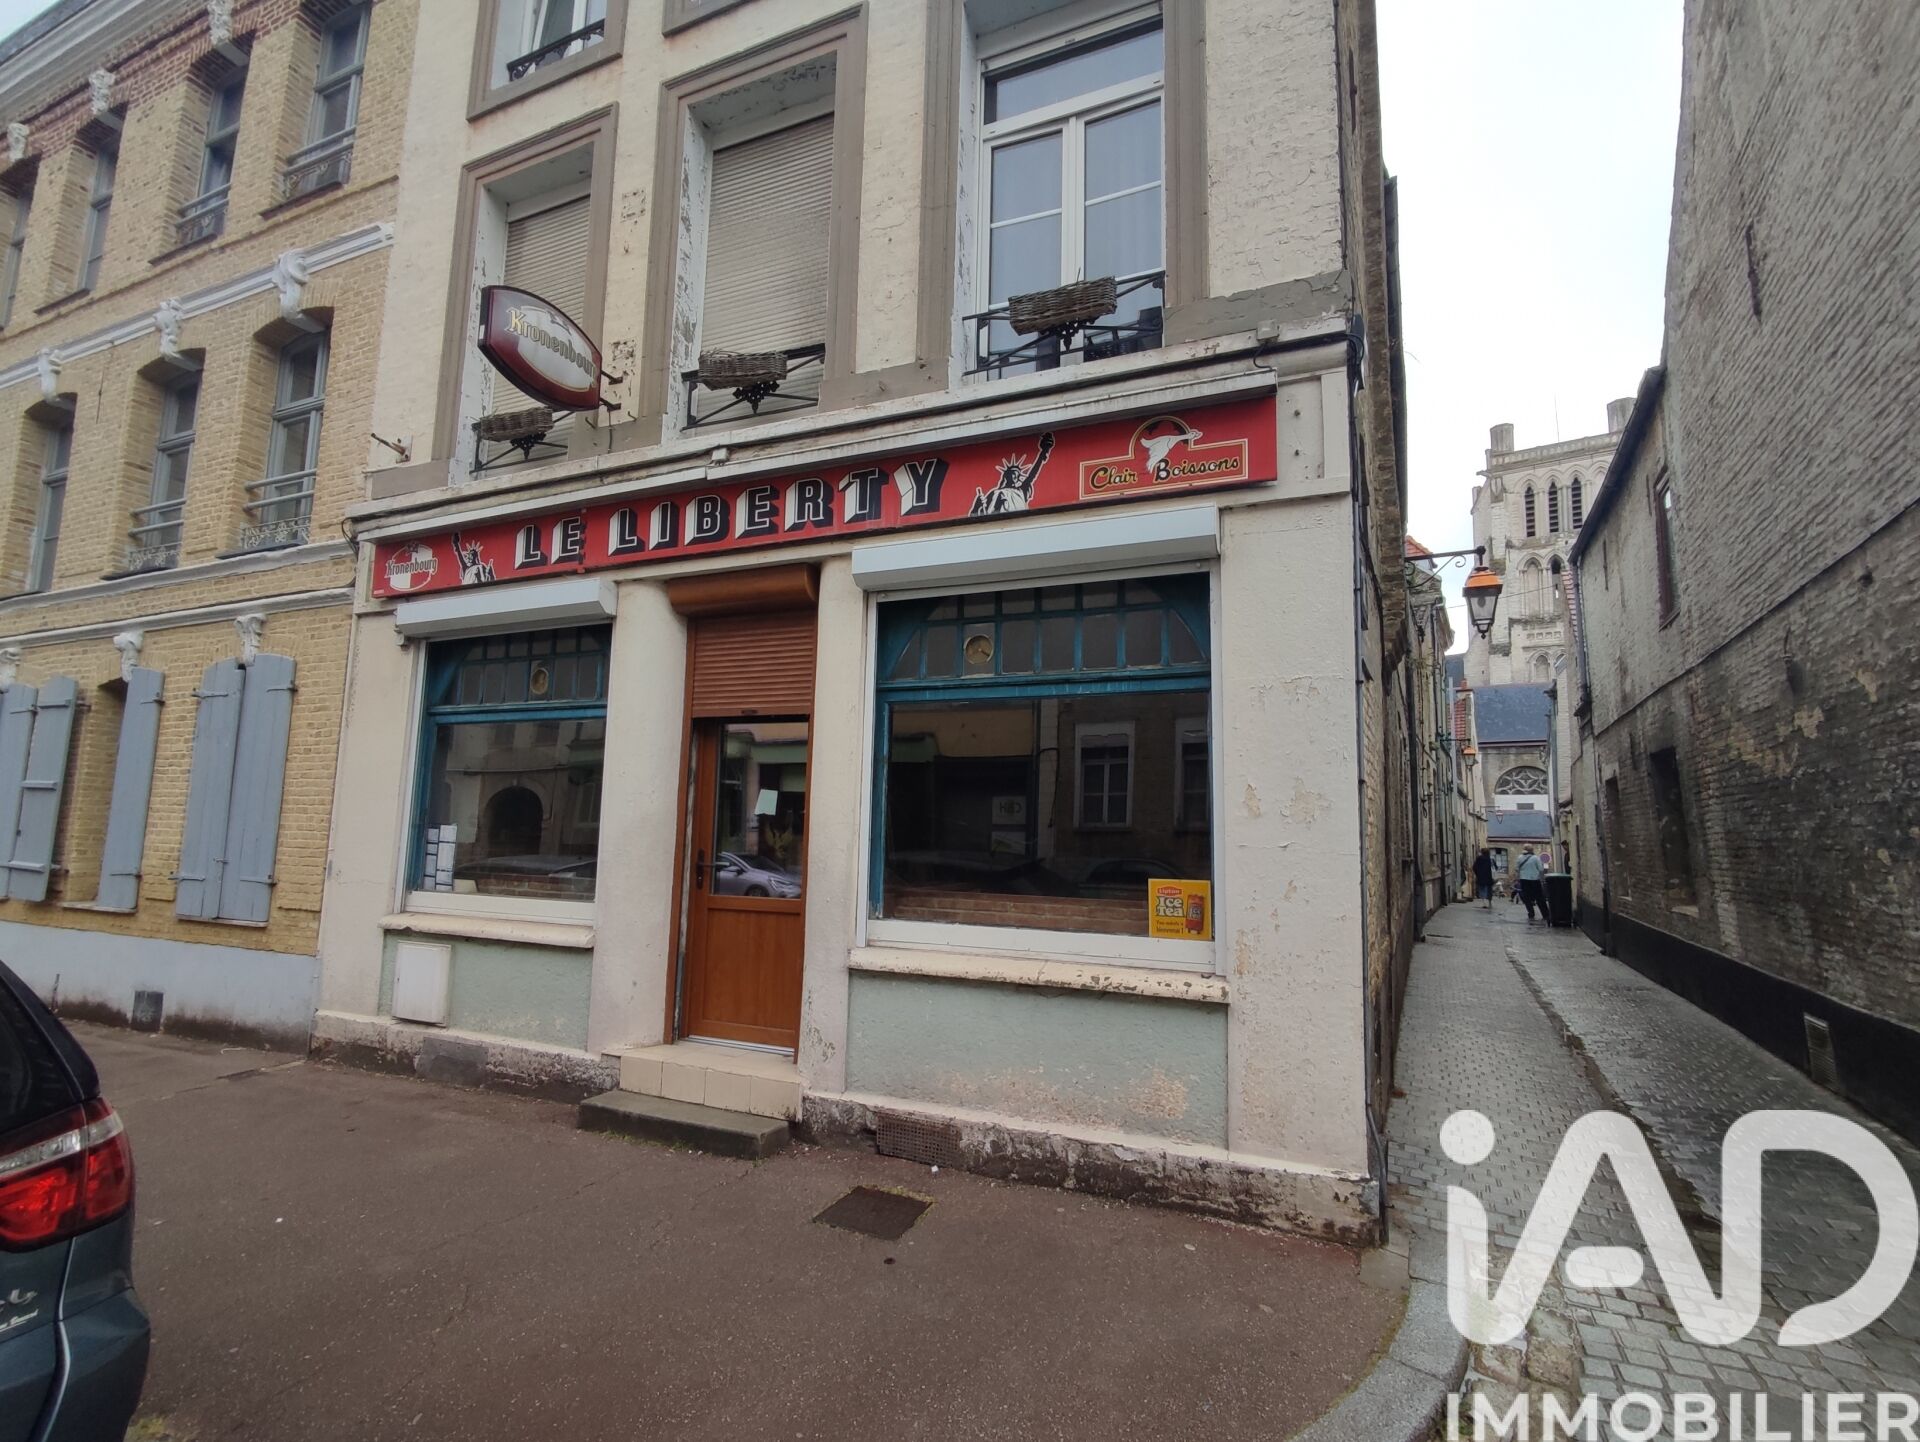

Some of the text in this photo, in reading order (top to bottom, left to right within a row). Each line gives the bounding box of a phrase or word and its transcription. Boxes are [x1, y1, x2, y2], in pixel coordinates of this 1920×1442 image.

[1090, 457, 1240, 489] Clair Boissons
[514, 458, 948, 570] LE LIBERTY
[385, 557, 438, 577] Kronenbourg
[1156, 896, 1183, 908] Ice
[1156, 906, 1185, 917] Tea
